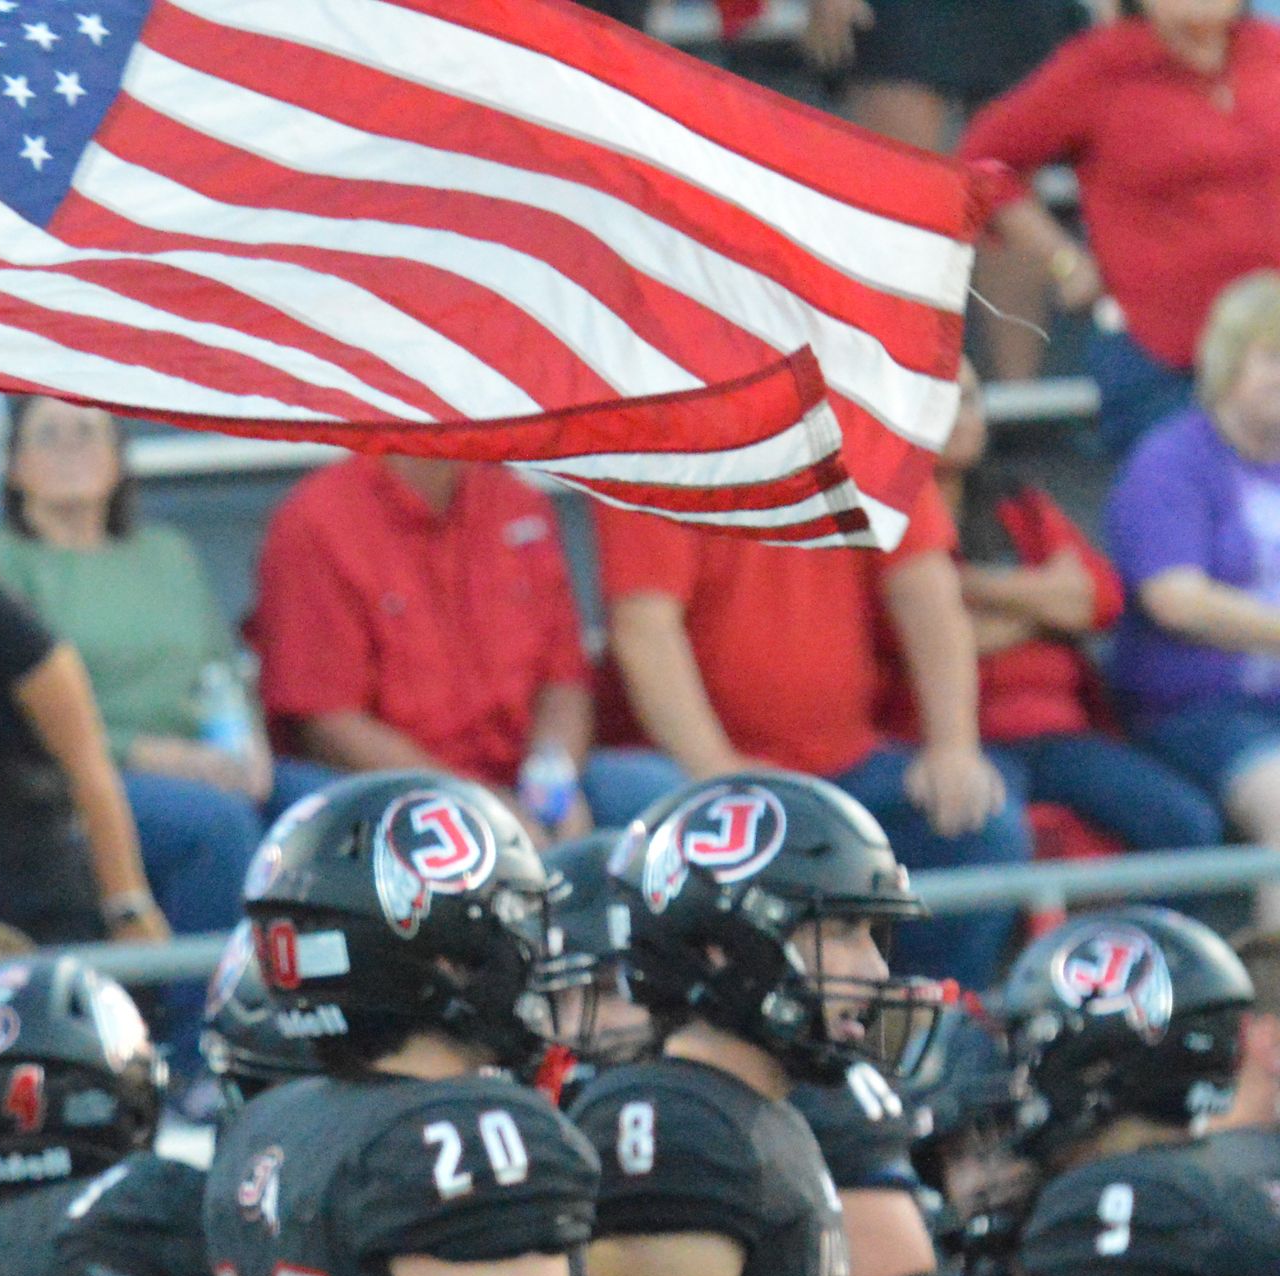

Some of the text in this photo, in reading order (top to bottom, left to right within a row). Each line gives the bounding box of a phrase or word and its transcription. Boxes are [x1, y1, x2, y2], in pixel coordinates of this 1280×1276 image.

[410, 797, 481, 879] J
[684, 796, 767, 866] J
[424, 1110, 528, 1199] 20
[618, 1101, 656, 1174] 8
